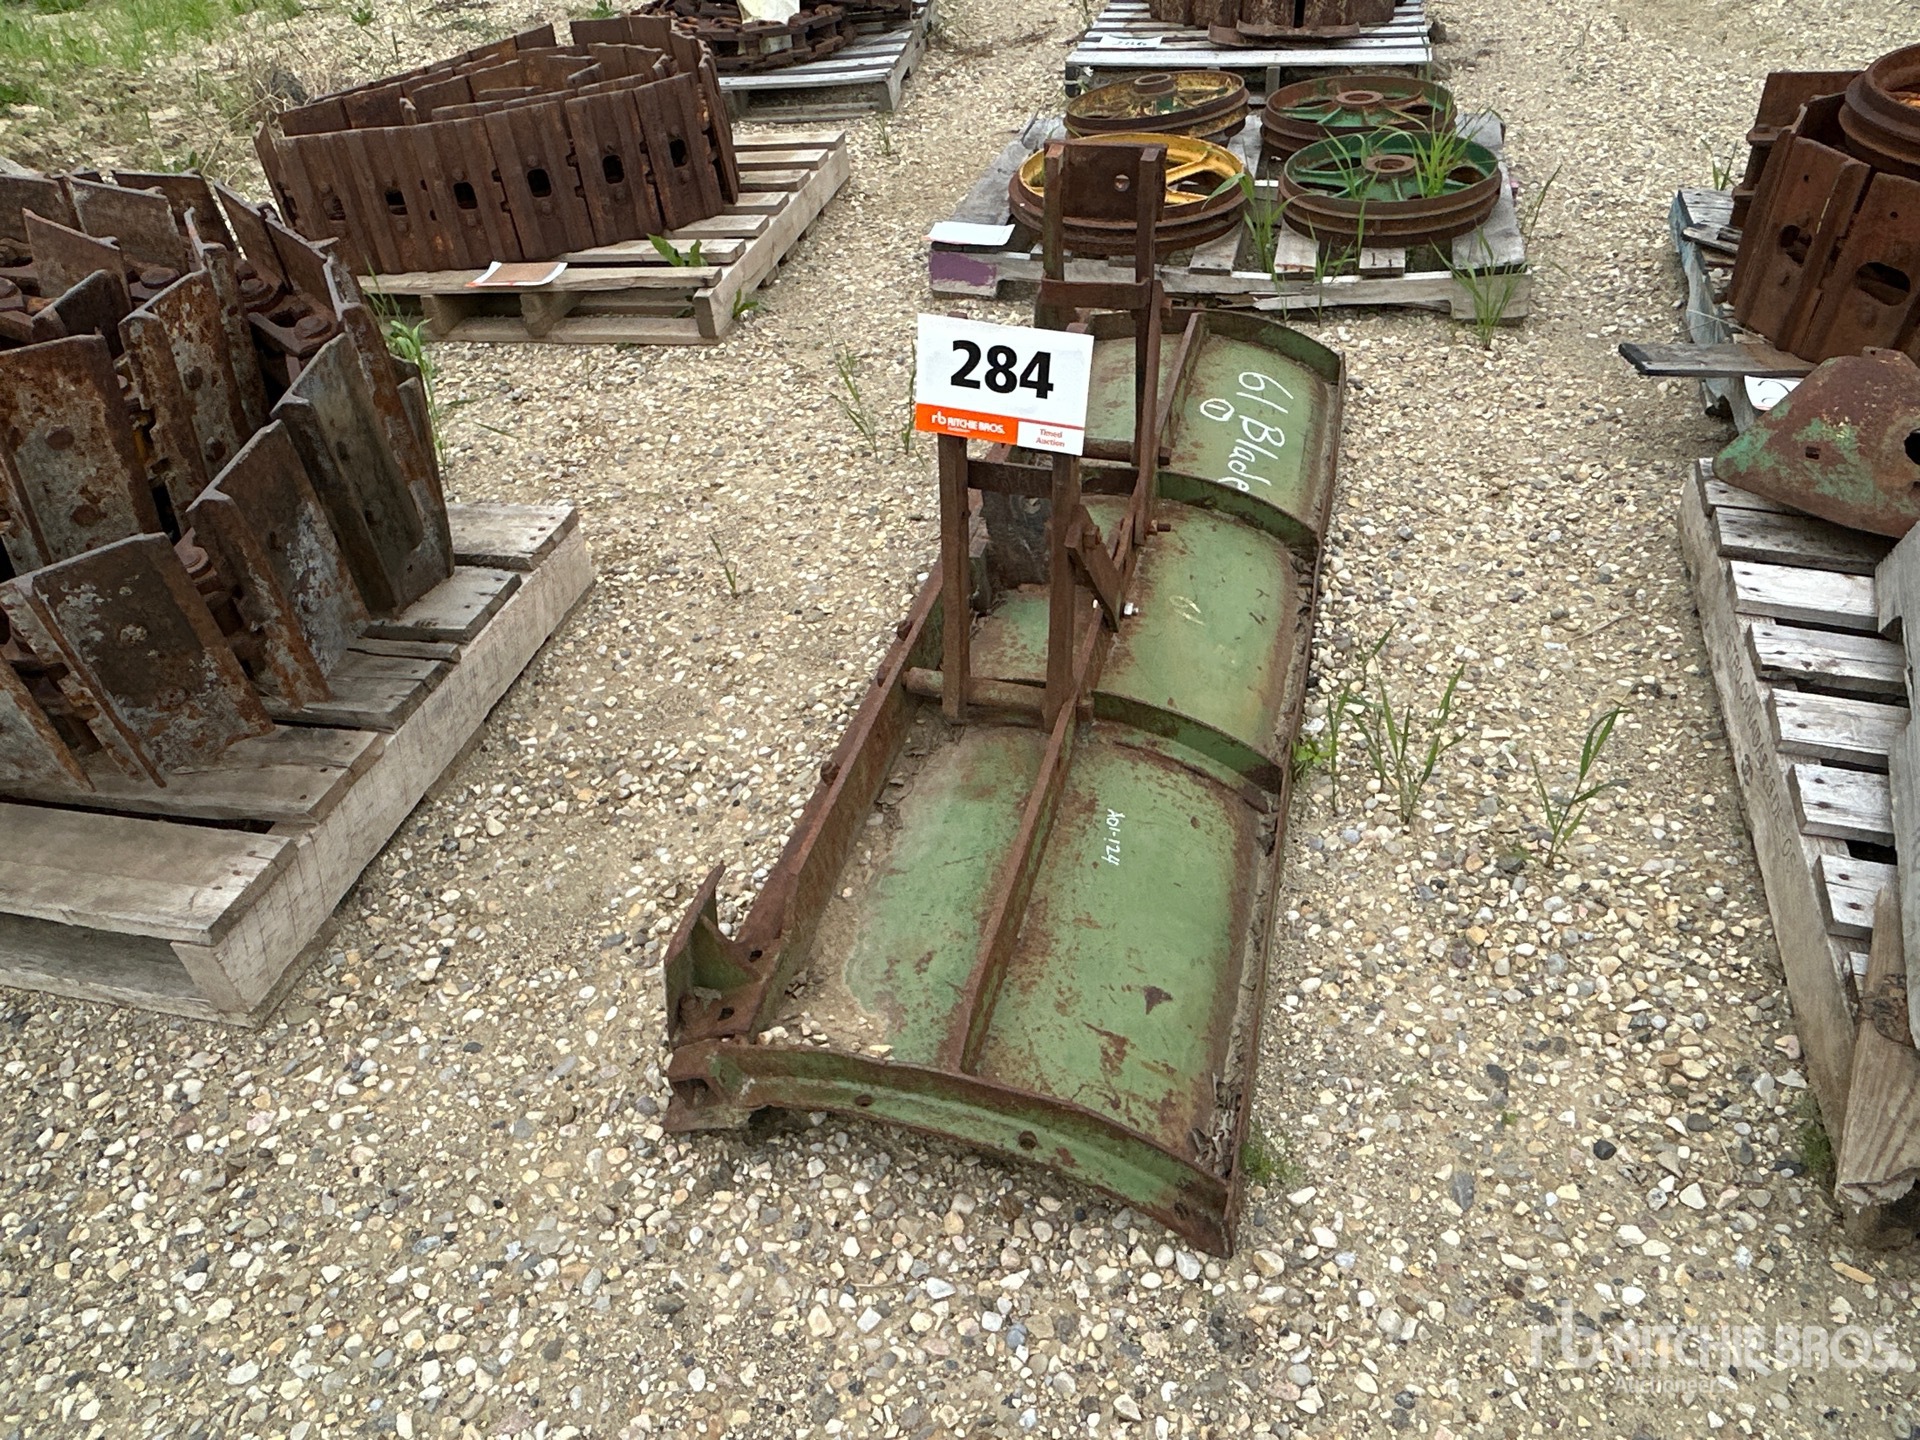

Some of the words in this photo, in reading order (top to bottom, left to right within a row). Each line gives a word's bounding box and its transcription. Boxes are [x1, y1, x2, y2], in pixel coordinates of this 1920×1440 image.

[951, 340, 1054, 399] 284
[1236, 371, 1294, 414] 61
[947, 417, 978, 430] RITCHIE
[1039, 428, 1063, 438] Timed
[1035, 437, 1066, 447] Auction
[1218, 414, 1286, 492] Blade
